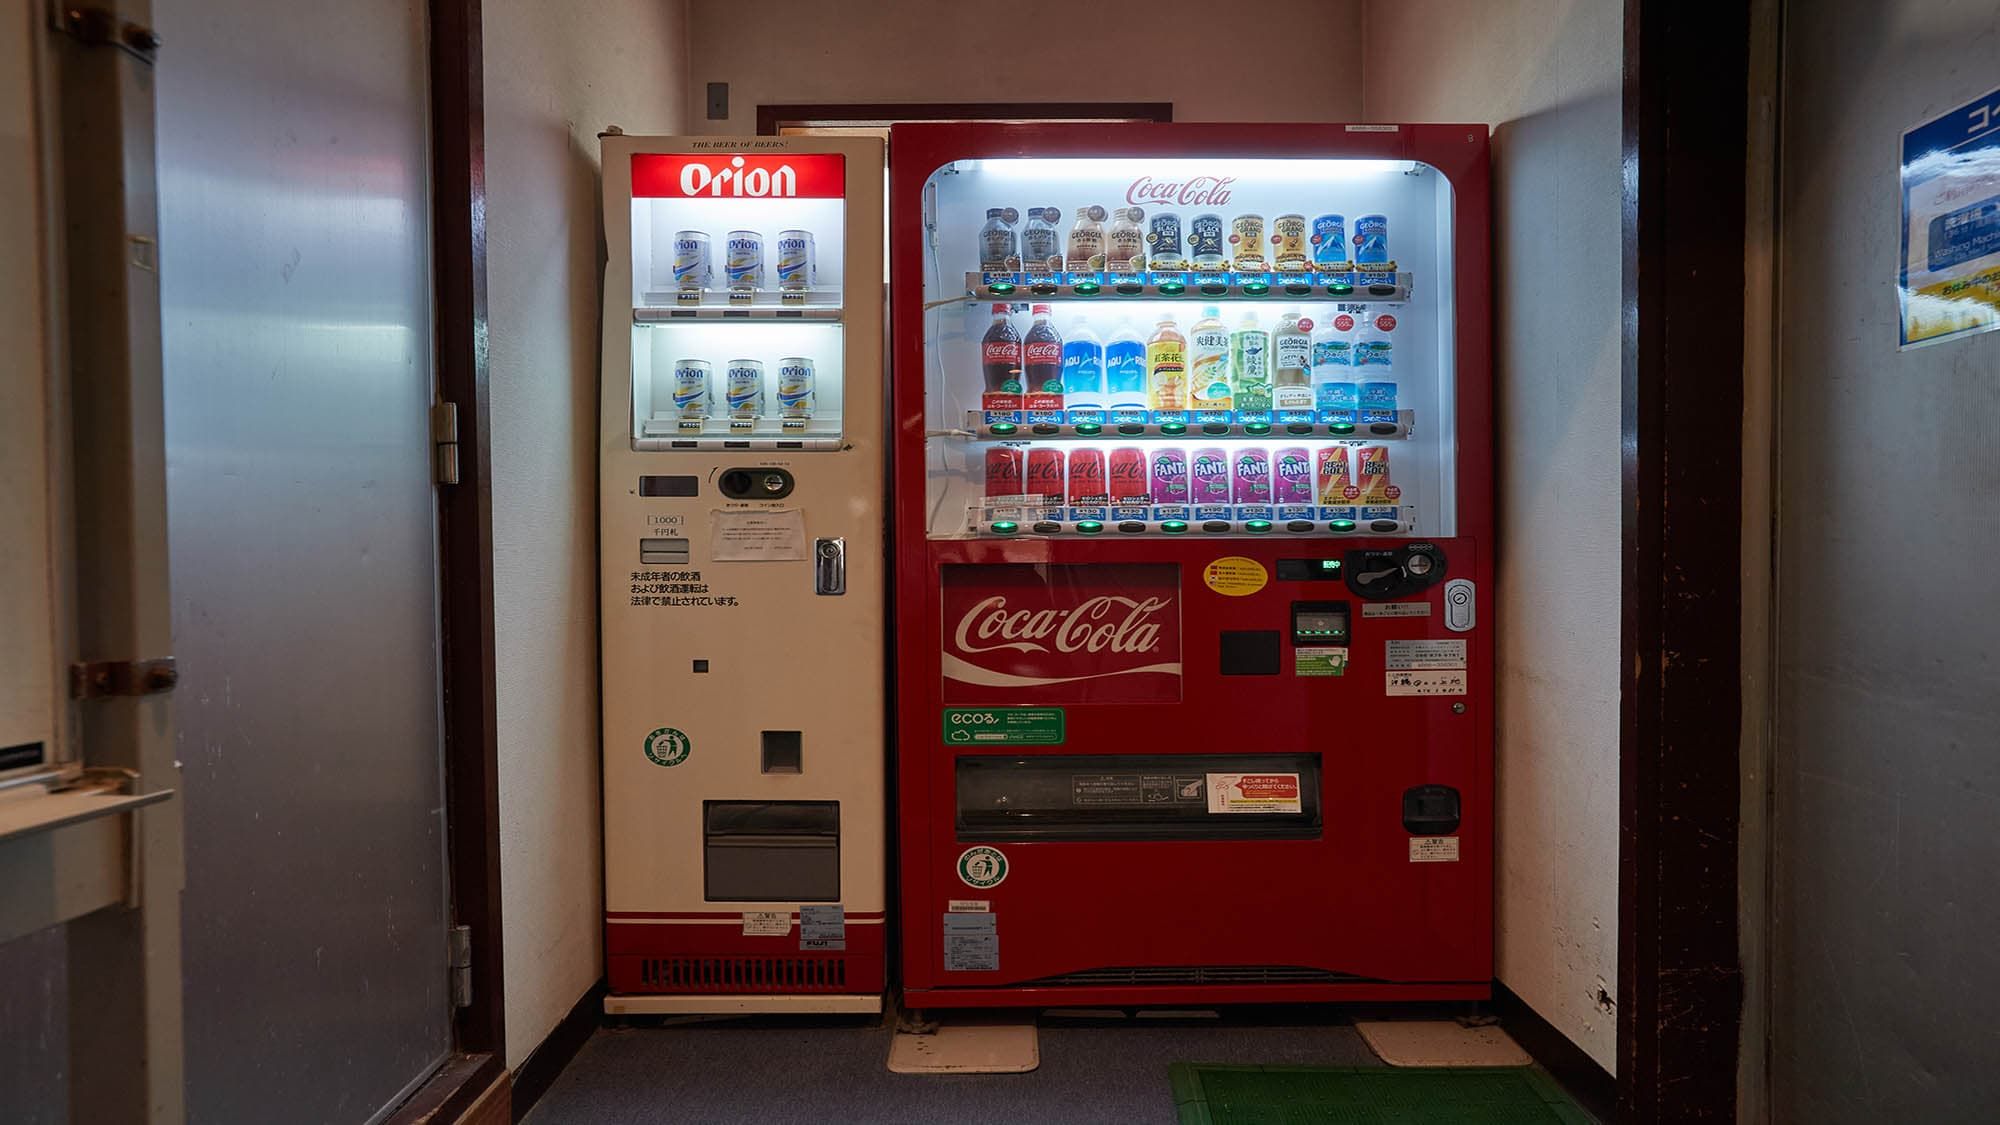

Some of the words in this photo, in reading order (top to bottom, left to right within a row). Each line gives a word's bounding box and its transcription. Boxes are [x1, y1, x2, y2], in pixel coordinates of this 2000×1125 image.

[691, 141, 710, 149] THE
[712, 141, 737, 149] BEER
[740, 141, 751, 149] OF
[680, 156, 797, 197] Orion
[1126, 175, 1240, 206] Coca-Cola
[675, 367, 704, 378] Orion
[728, 367, 758, 378] Orion
[782, 365, 811, 377] Orion
[1278, 462, 1311, 477] FANT
[655, 516, 678, 524] 1000
[630, 571, 701, 581] 未成年者の飲酒
[630, 584, 709, 594] および飲酒運転は
[630, 596, 739, 607] 法律で禁止されています。
[955, 596, 1172, 654] Coca-Cola
